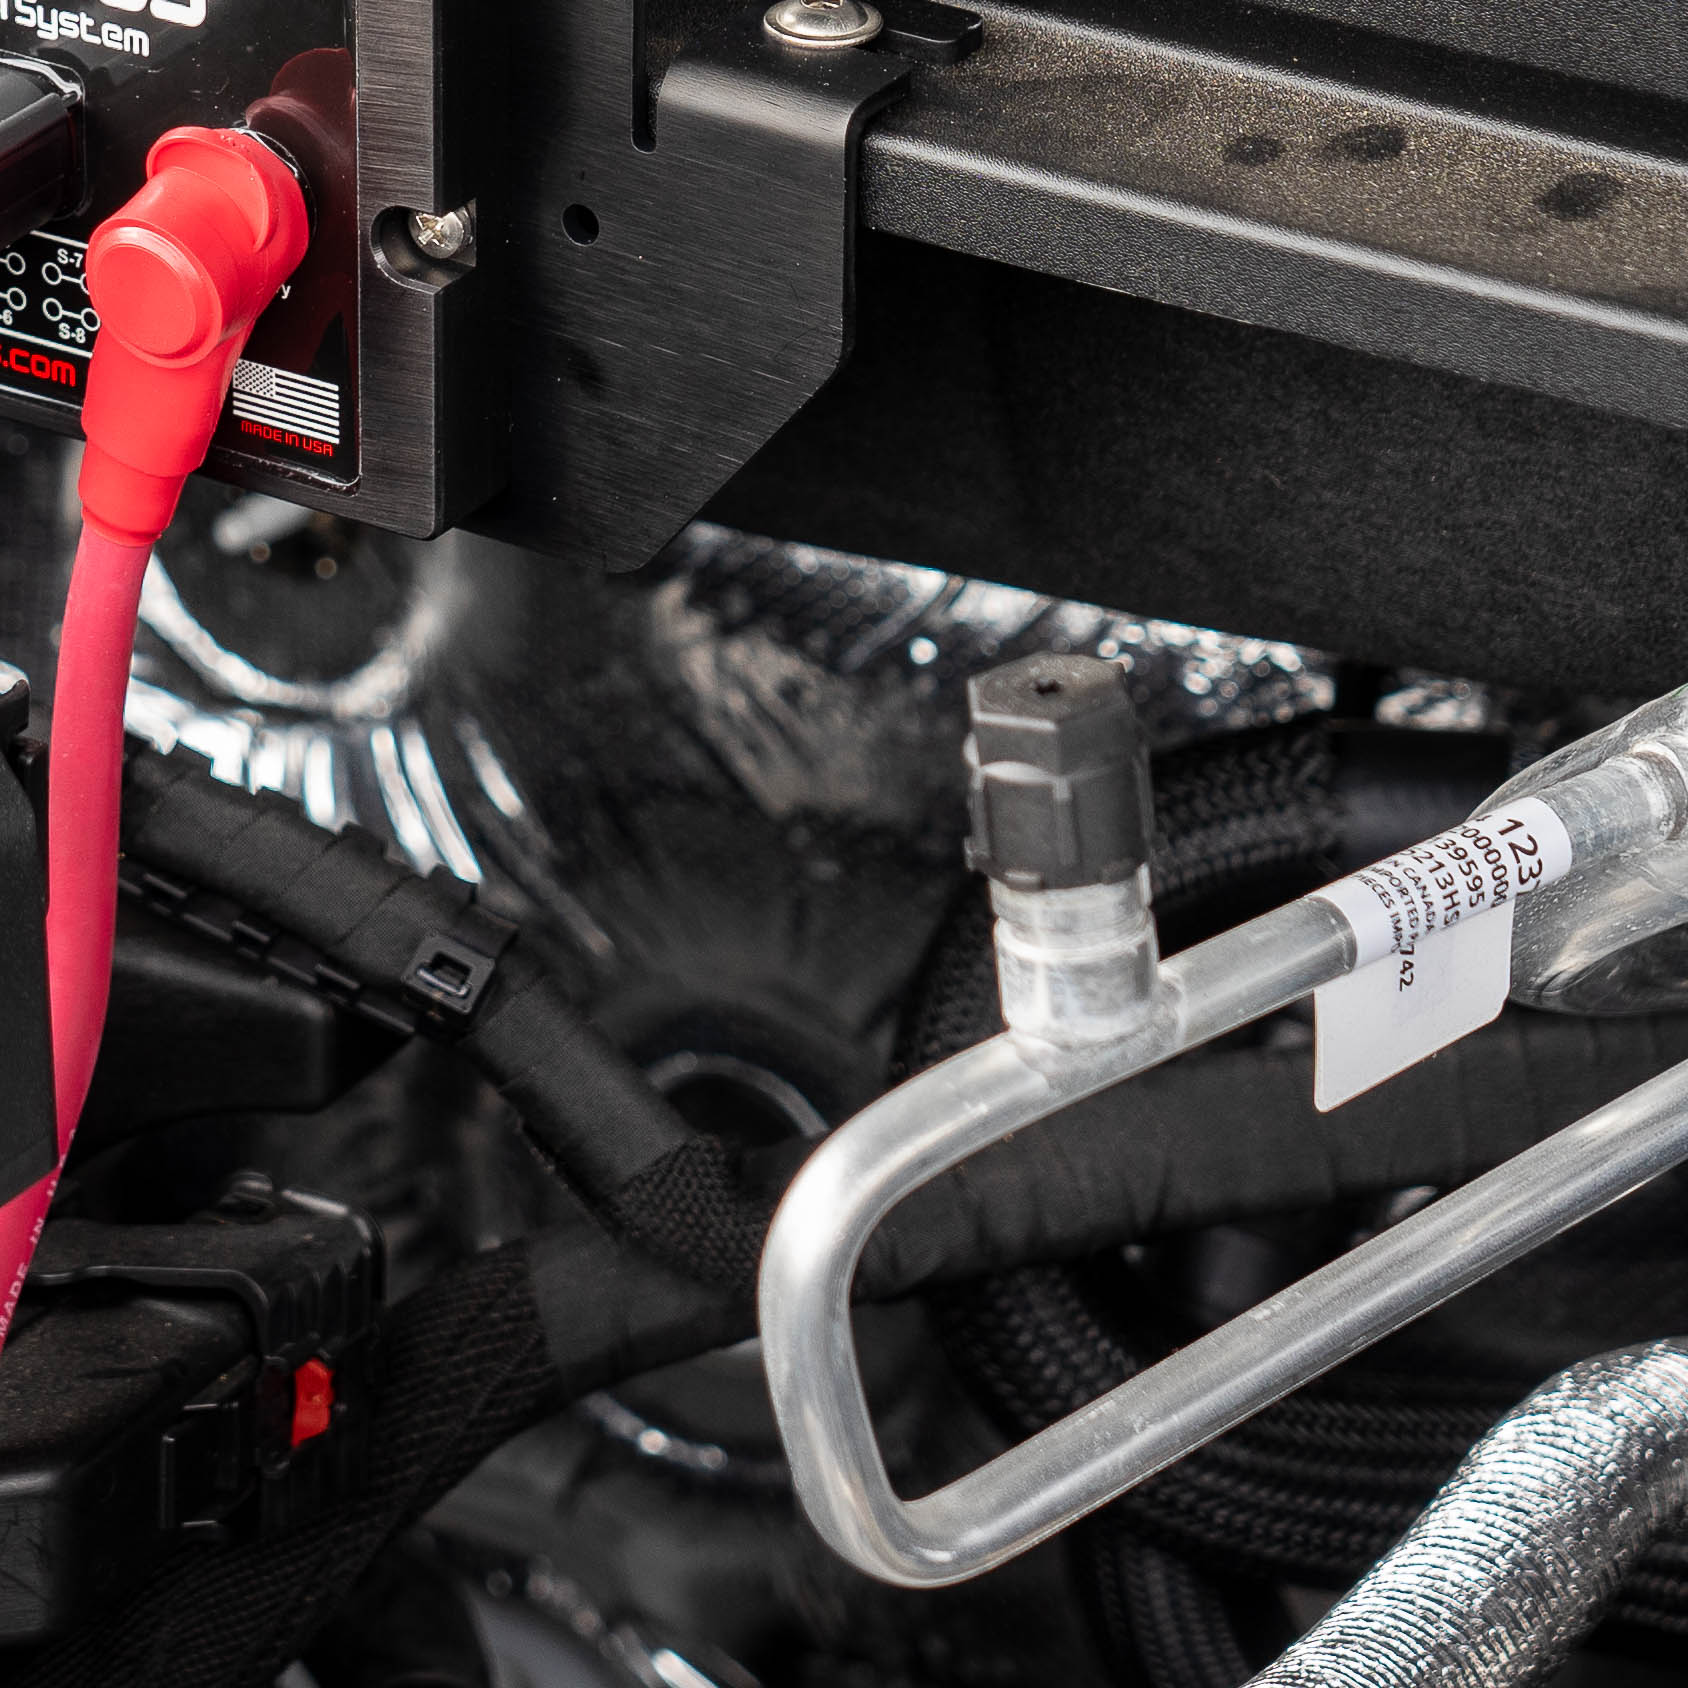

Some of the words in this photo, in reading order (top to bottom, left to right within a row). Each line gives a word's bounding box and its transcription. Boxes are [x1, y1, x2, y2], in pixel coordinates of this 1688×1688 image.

[57, 248, 85, 269] S-7
[58, 322, 86, 344] S-8
[241, 419, 282, 443] MADE
[284, 431, 300, 448] IN
[302, 437, 334, 457] USA
[1429, 836, 1485, 909] 39595
